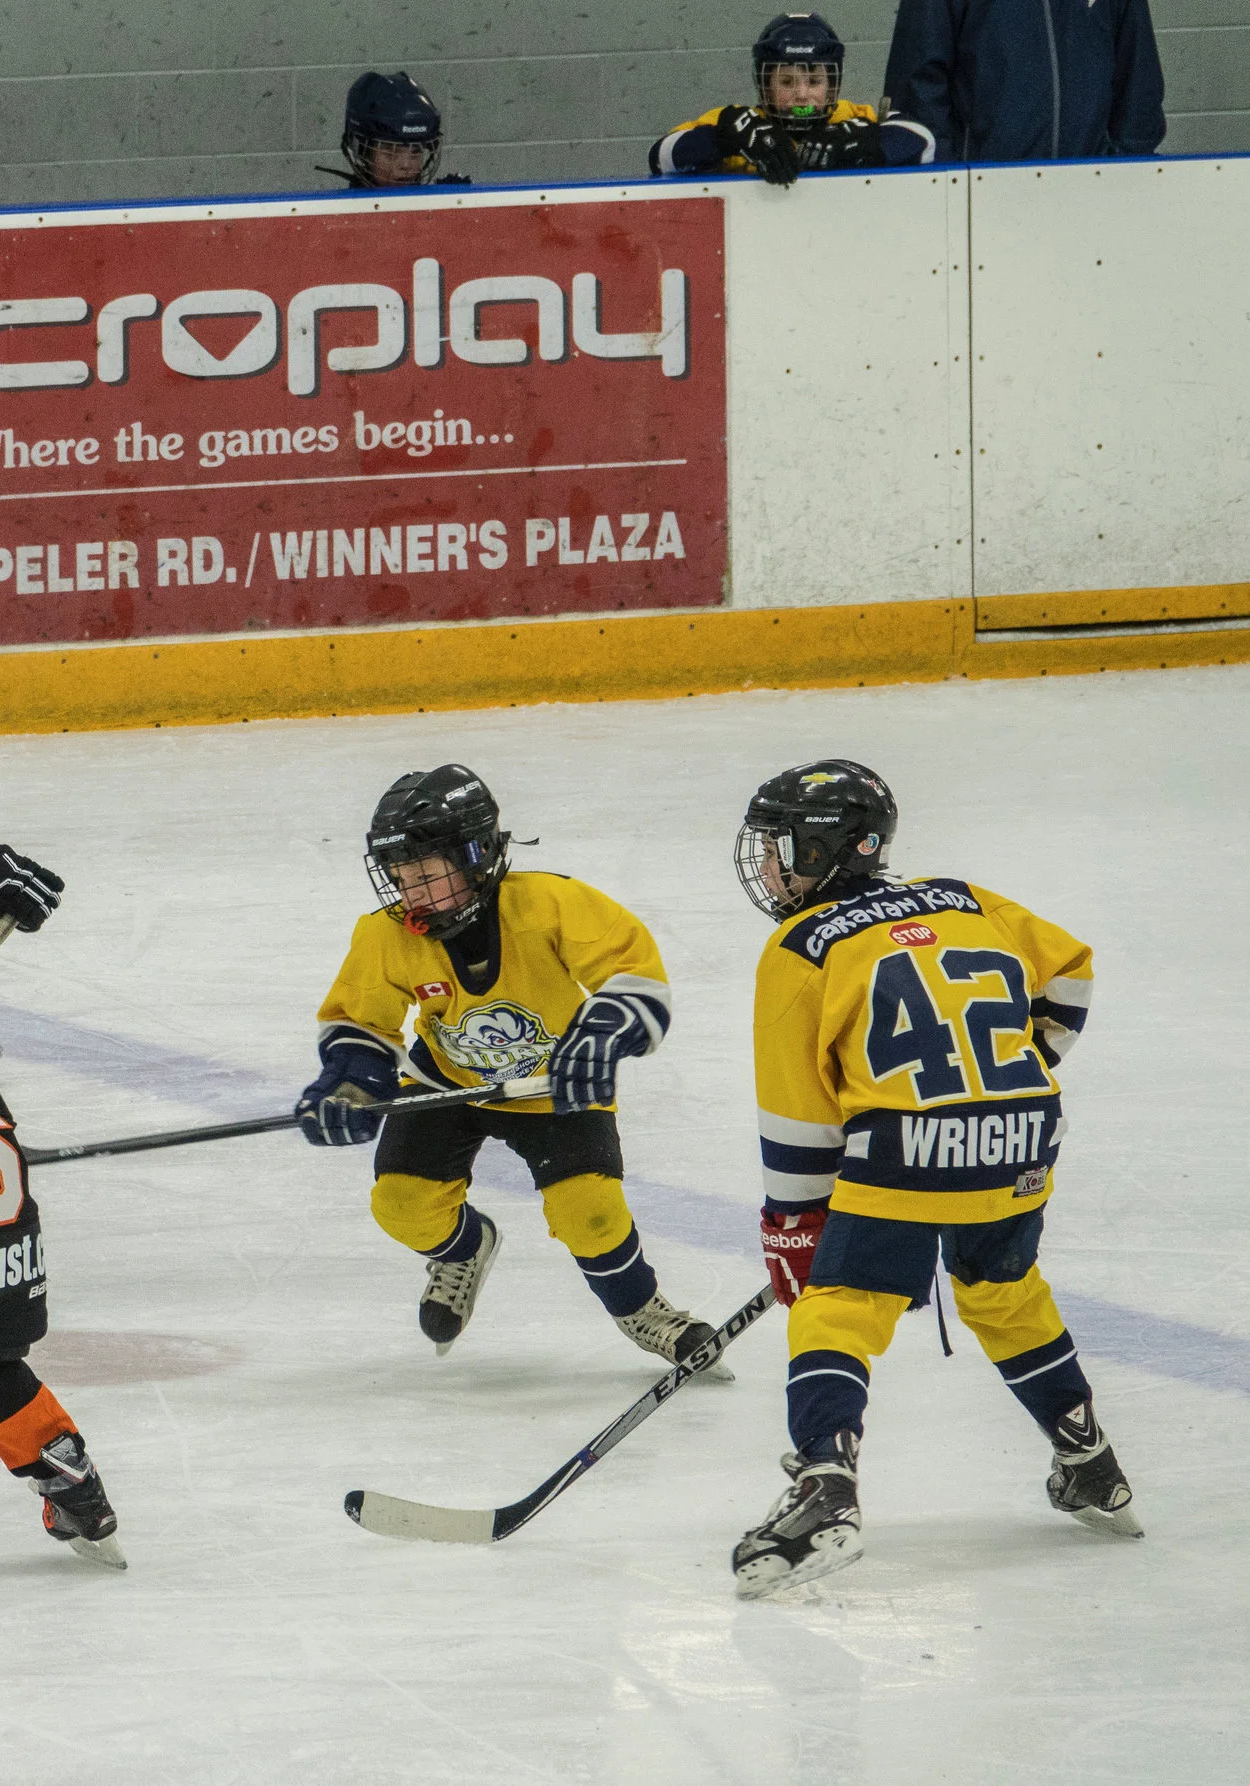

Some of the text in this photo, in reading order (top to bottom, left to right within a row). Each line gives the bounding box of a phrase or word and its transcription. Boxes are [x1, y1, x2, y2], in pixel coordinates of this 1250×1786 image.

[114, 421, 184, 463] the
[198, 425, 339, 468] games
[354, 409, 516, 457] begin...
[270, 519, 509, 581] WINNER'S
[525, 511, 686, 567] PLAZA
[445, 780, 481, 802] BAUER
[372, 833, 406, 847] BAUER
[892, 926, 932, 944] STOP
[865, 947, 1052, 1105] 42
[900, 1110, 1045, 1169] WRIGHT
[762, 1232, 816, 1249] eebok
[651, 1296, 769, 1404] EASTON
